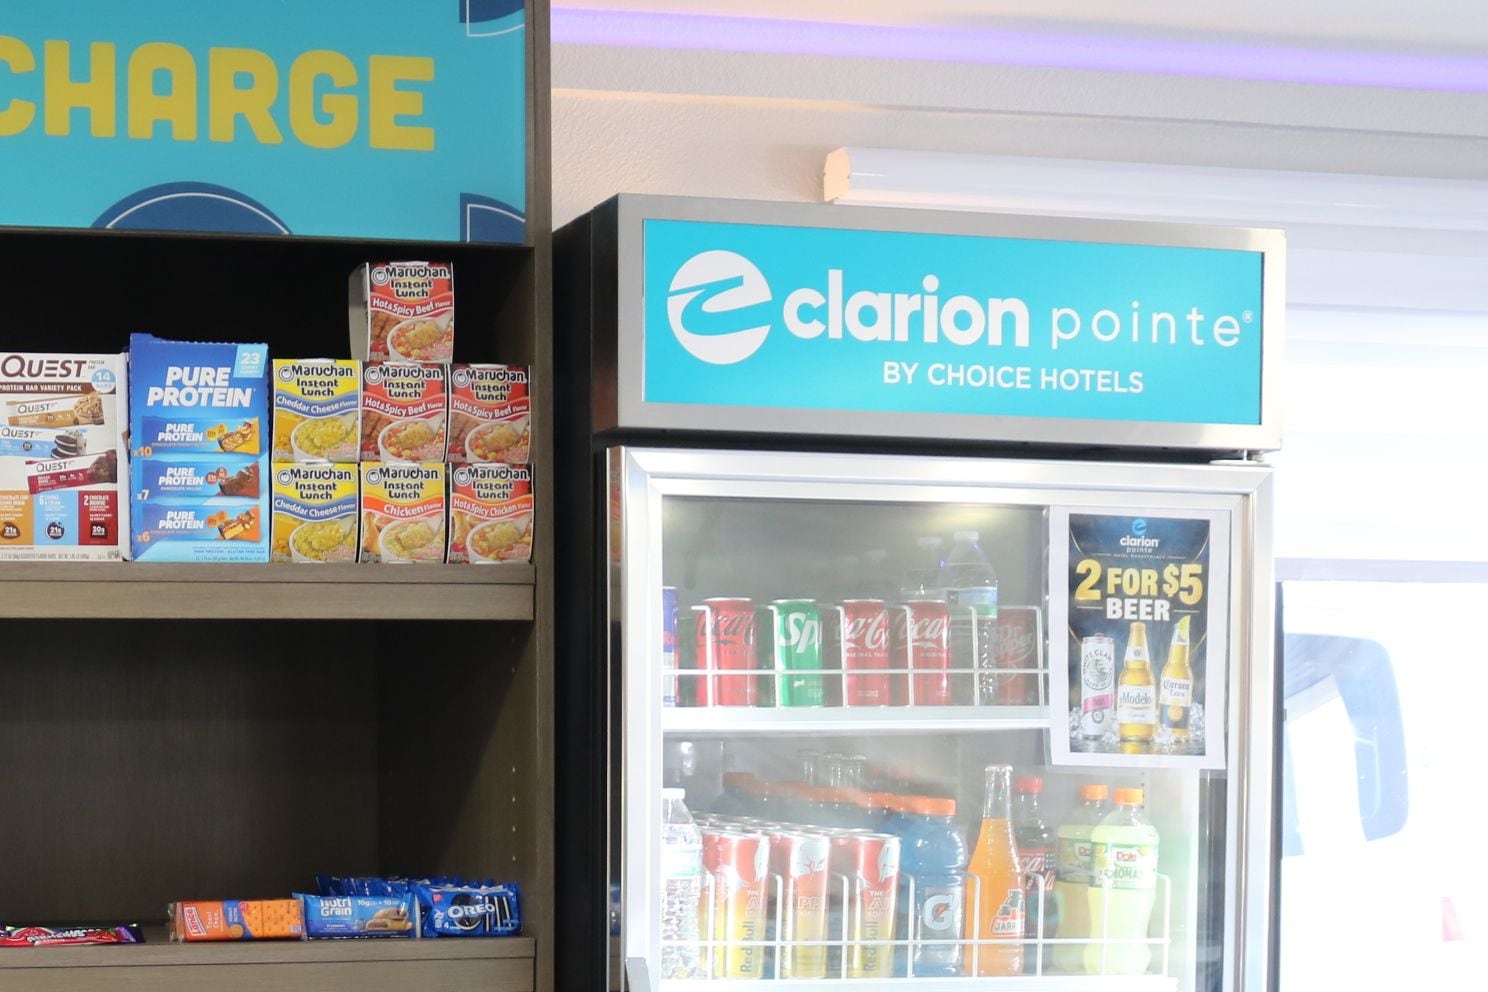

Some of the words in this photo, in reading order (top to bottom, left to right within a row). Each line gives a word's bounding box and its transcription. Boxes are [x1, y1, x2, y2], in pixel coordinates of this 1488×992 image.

[385, 266, 447, 278] Maruchan
[391, 281, 432, 289] Instant
[396, 289, 428, 297] Lunch
[416, 301, 434, 314] Beef
[783, 269, 1029, 346] clarion
[242, 353, 259, 364] 23
[1, 355, 87, 378] QUEST
[292, 365, 352, 376] Maruchan
[96, 373, 110, 381] 14
[166, 367, 231, 386] PURE
[379, 367, 441, 378] Maruchan
[468, 370, 526, 381] Maruchan
[883, 362, 918, 383] BY
[927, 364, 1030, 389] CHOICE
[1040, 369, 1144, 394] HOTELS
[384, 381, 425, 389] Instant
[302, 387, 334, 396] Lunch
[389, 389, 421, 398] Lunch
[476, 392, 506, 400] Lunch
[147, 388, 254, 407] PROTEIN
[18, 404, 51, 413] QUEST
[277, 396, 310, 412] Cheddar
[311, 403, 339, 413] Cheese
[408, 403, 426, 415] Beef
[494, 404, 512, 416] Beef
[2, 428, 34, 438] QUEST
[166, 424, 194, 432] PURE
[158, 432, 203, 441] PROTEIN
[134, 447, 152, 456] x10
[36, 462, 68, 471] QUEST
[167, 468, 195, 476] PURE
[290, 469, 351, 480] Maruchan
[379, 468, 438, 479] Maruchan
[468, 468, 527, 479] Maruchan
[159, 476, 204, 485] PROTEIN
[384, 481, 424, 490] Instant
[473, 482, 513, 490] Instant
[295, 482, 336, 491] Instant
[137, 490, 149, 500] x7
[300, 491, 332, 500] Lunch
[389, 490, 420, 498] Lunch
[477, 490, 509, 498] Lunch
[275, 500, 308, 516] Cheddar
[309, 506, 337, 517] Cheese
[384, 504, 423, 517] Chicken
[490, 504, 517, 516] Chicken
[167, 512, 195, 520] PURE
[159, 520, 204, 529] PROTEIN
[137, 531, 150, 542] x6
[1120, 536, 1159, 547] clarion
[1075, 559, 1102, 600] 2
[1107, 568, 1158, 595] FOR
[1163, 564, 1202, 605] $5
[1106, 598, 1170, 621] BEER
[1163, 679, 1190, 691] Corona
[1121, 691, 1151, 704] Modelo
[1116, 852, 1137, 862] Dole
[321, 907, 352, 916] Grain
[448, 903, 495, 918] OREO
[188, 909, 199, 934] Lance
